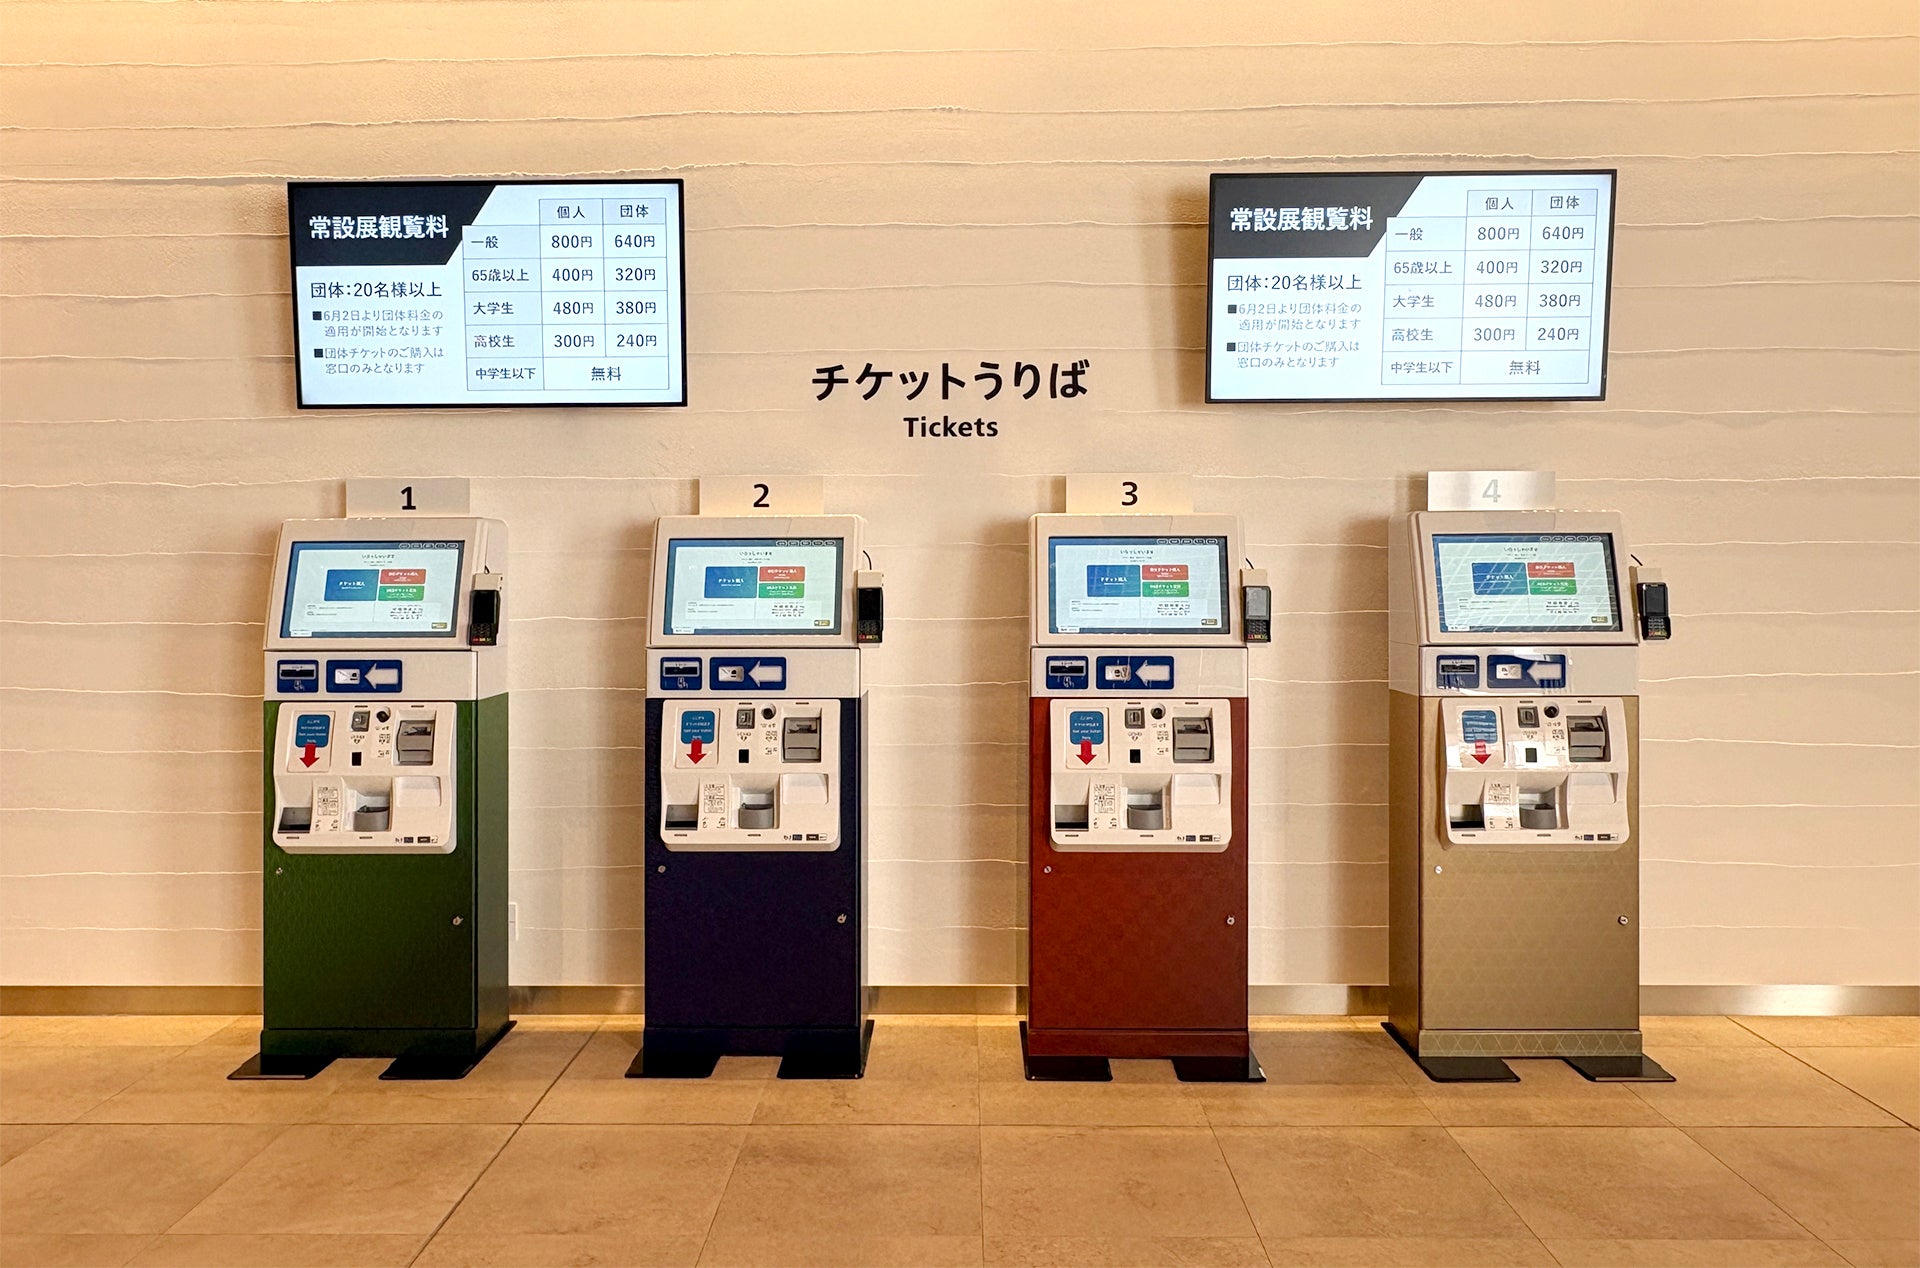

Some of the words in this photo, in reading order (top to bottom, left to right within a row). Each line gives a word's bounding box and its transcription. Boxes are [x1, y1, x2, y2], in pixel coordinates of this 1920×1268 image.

[1484, 196, 1515, 211] 個人
[1549, 194, 1580, 210] 団体
[556, 205, 586, 219] 個人
[619, 203, 649, 219] 団体
[1229, 205, 1374, 232] 常設展観覧料
[308, 214, 450, 240] 常設展観覧料
[1394, 227, 1424, 241] 一般
[1477, 226, 1520, 241] 800円
[1542, 225, 1584, 241] 640円
[470, 235, 499, 249] 一般
[551, 234, 593, 249] 800円
[614, 234, 656, 249] 640円
[471, 268, 530, 283] 65歳以上
[551, 267, 593, 282] 400円
[615, 267, 656, 282] 320円
[1393, 260, 1453, 275] 65歳以上
[1476, 260, 1518, 275] 400円
[1540, 259, 1583, 274] 320円
[472, 301, 515, 315] 大学生
[552, 301, 594, 315] 480円
[615, 300, 657, 315] 380円
[1392, 294, 1435, 309] 大学生
[1474, 294, 1517, 308] 480円
[1539, 293, 1581, 308] 380円
[473, 334, 516, 349] 高校生
[553, 334, 595, 348] 300円
[616, 333, 657, 348] 240円
[1391, 327, 1434, 342] 高校生
[1473, 327, 1516, 342] 300円
[1537, 327, 1579, 341] 240円
[325, 362, 425, 375] 窓口のみとなります
[475, 367, 537, 381] 中学生以下
[590, 366, 622, 382] 無料
[1390, 361, 1454, 375] 中学生以下
[1508, 359, 1541, 376] 無料
[812, 359, 1090, 401] チケットうりば
[902, 415, 999, 438] Tickets
[400, 486, 417, 510] 1
[752, 483, 770, 508] 2
[1121, 481, 1138, 507] 3
[1481, 478, 1502, 503] 4
